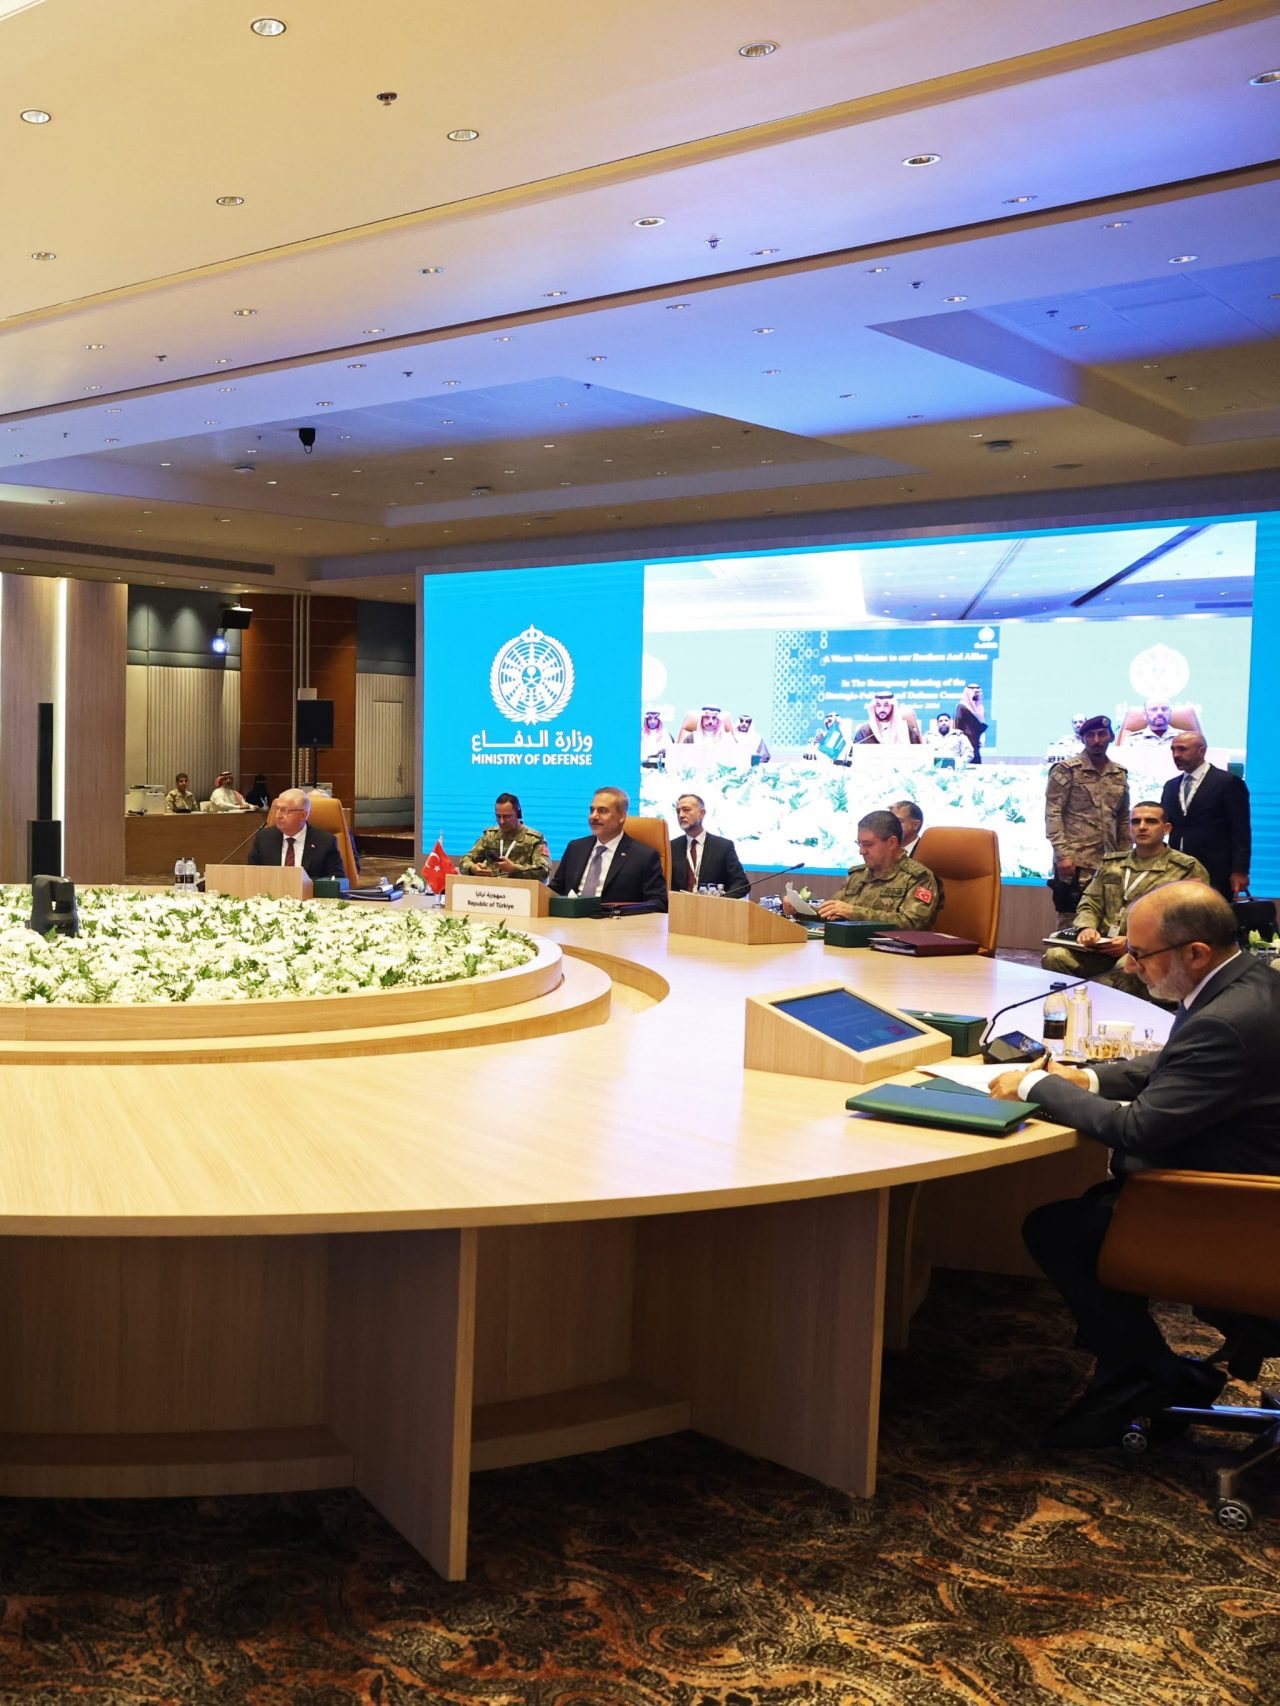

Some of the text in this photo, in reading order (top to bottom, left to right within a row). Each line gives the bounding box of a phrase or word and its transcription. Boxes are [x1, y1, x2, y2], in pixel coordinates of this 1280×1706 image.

[471, 729, 593, 752] وزارة الدفاع
[471, 753, 593, 765] MINISTRY OF DEFENSE
[496, 901, 514, 910] Türkiye
